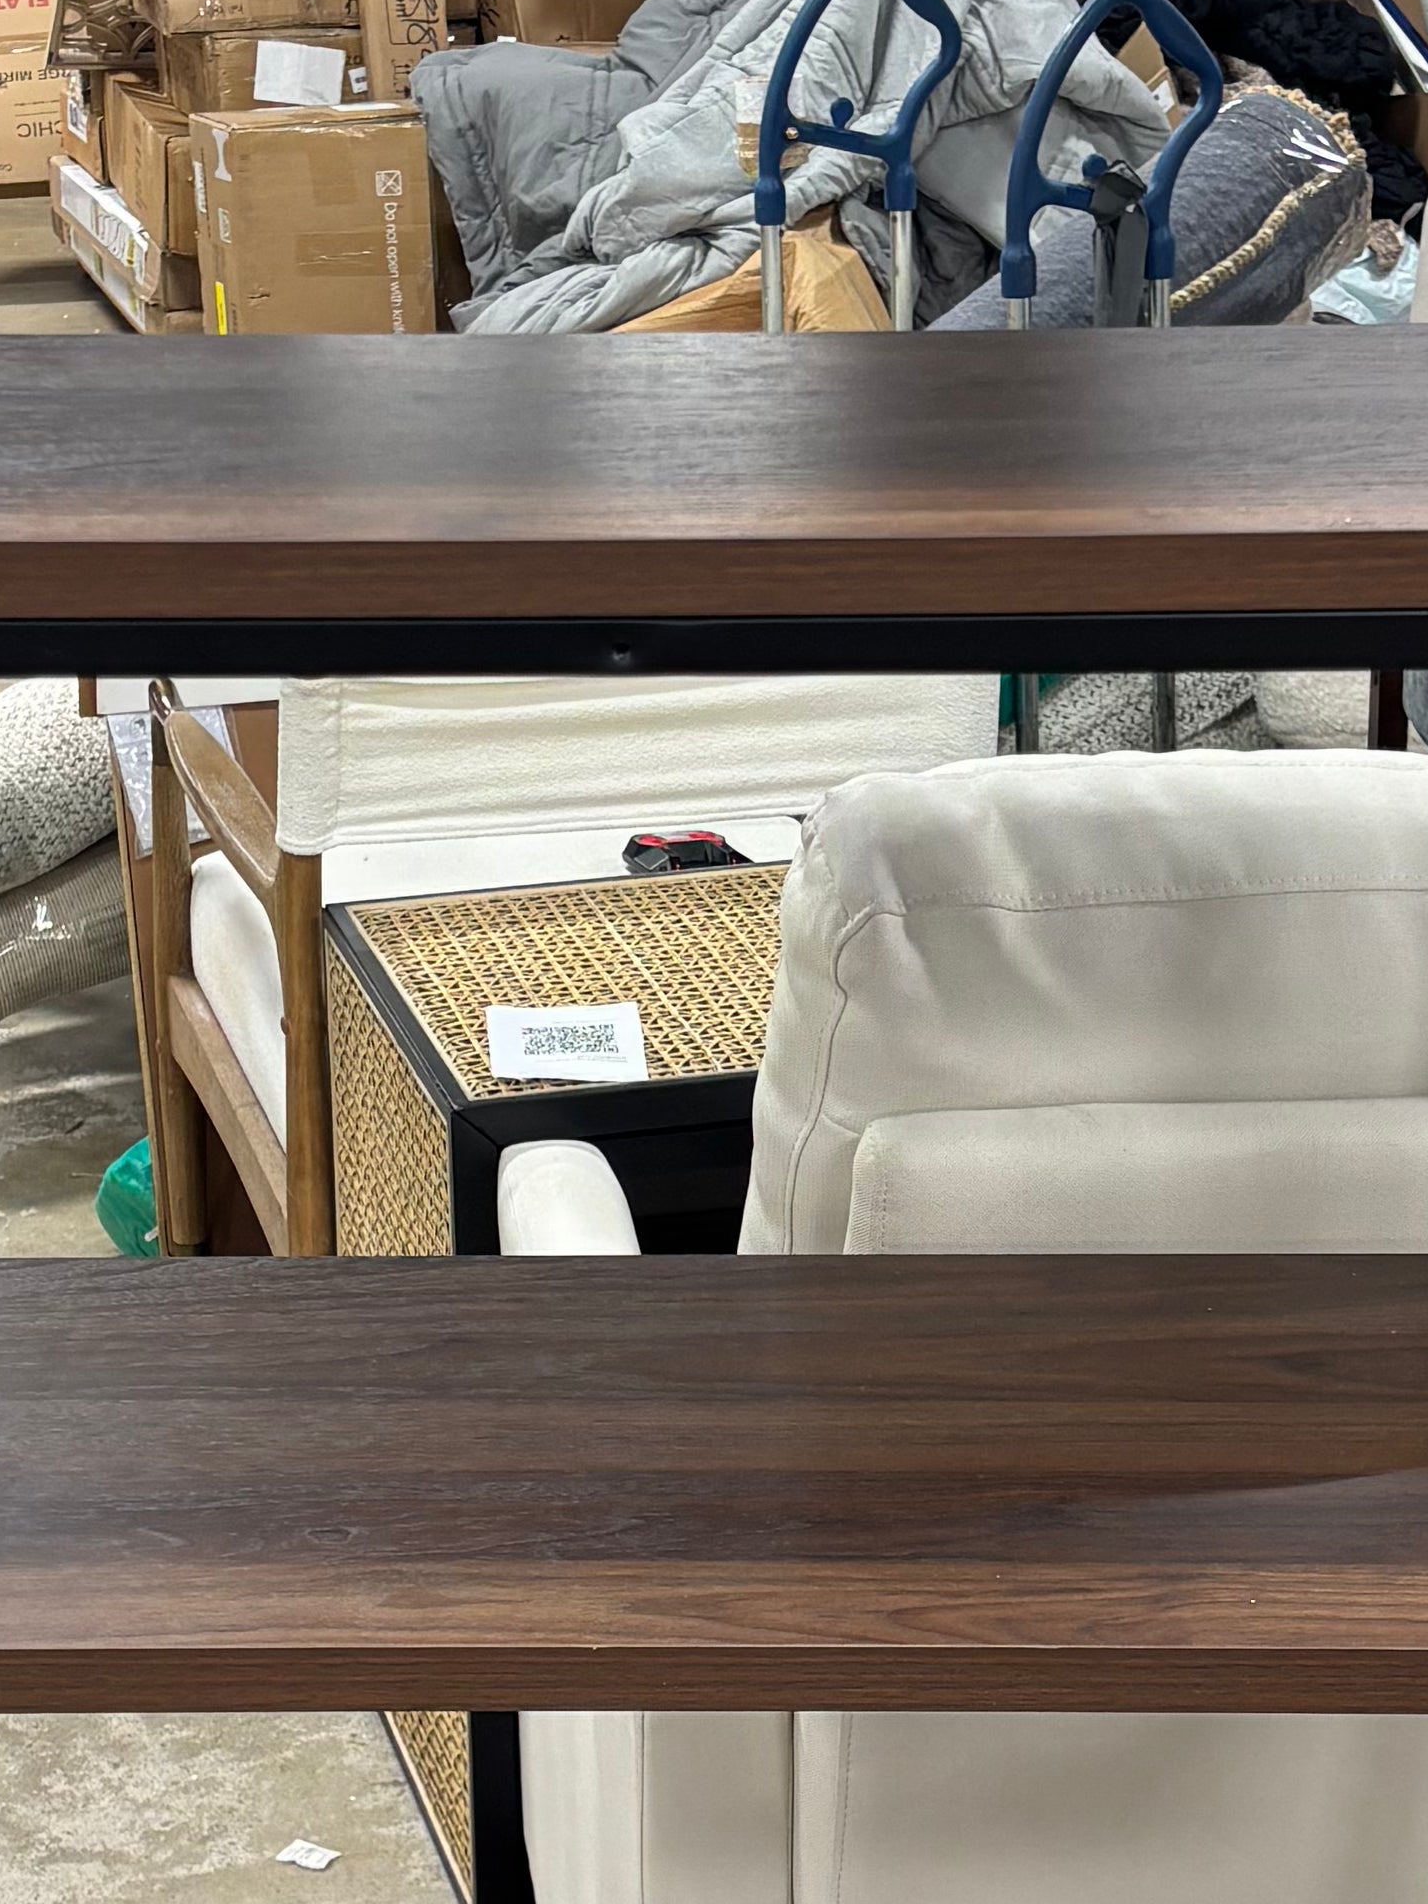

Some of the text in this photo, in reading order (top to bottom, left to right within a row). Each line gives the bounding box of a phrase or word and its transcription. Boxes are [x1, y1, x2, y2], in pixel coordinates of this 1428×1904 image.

[383, 201, 406, 334] Do not open with knif
